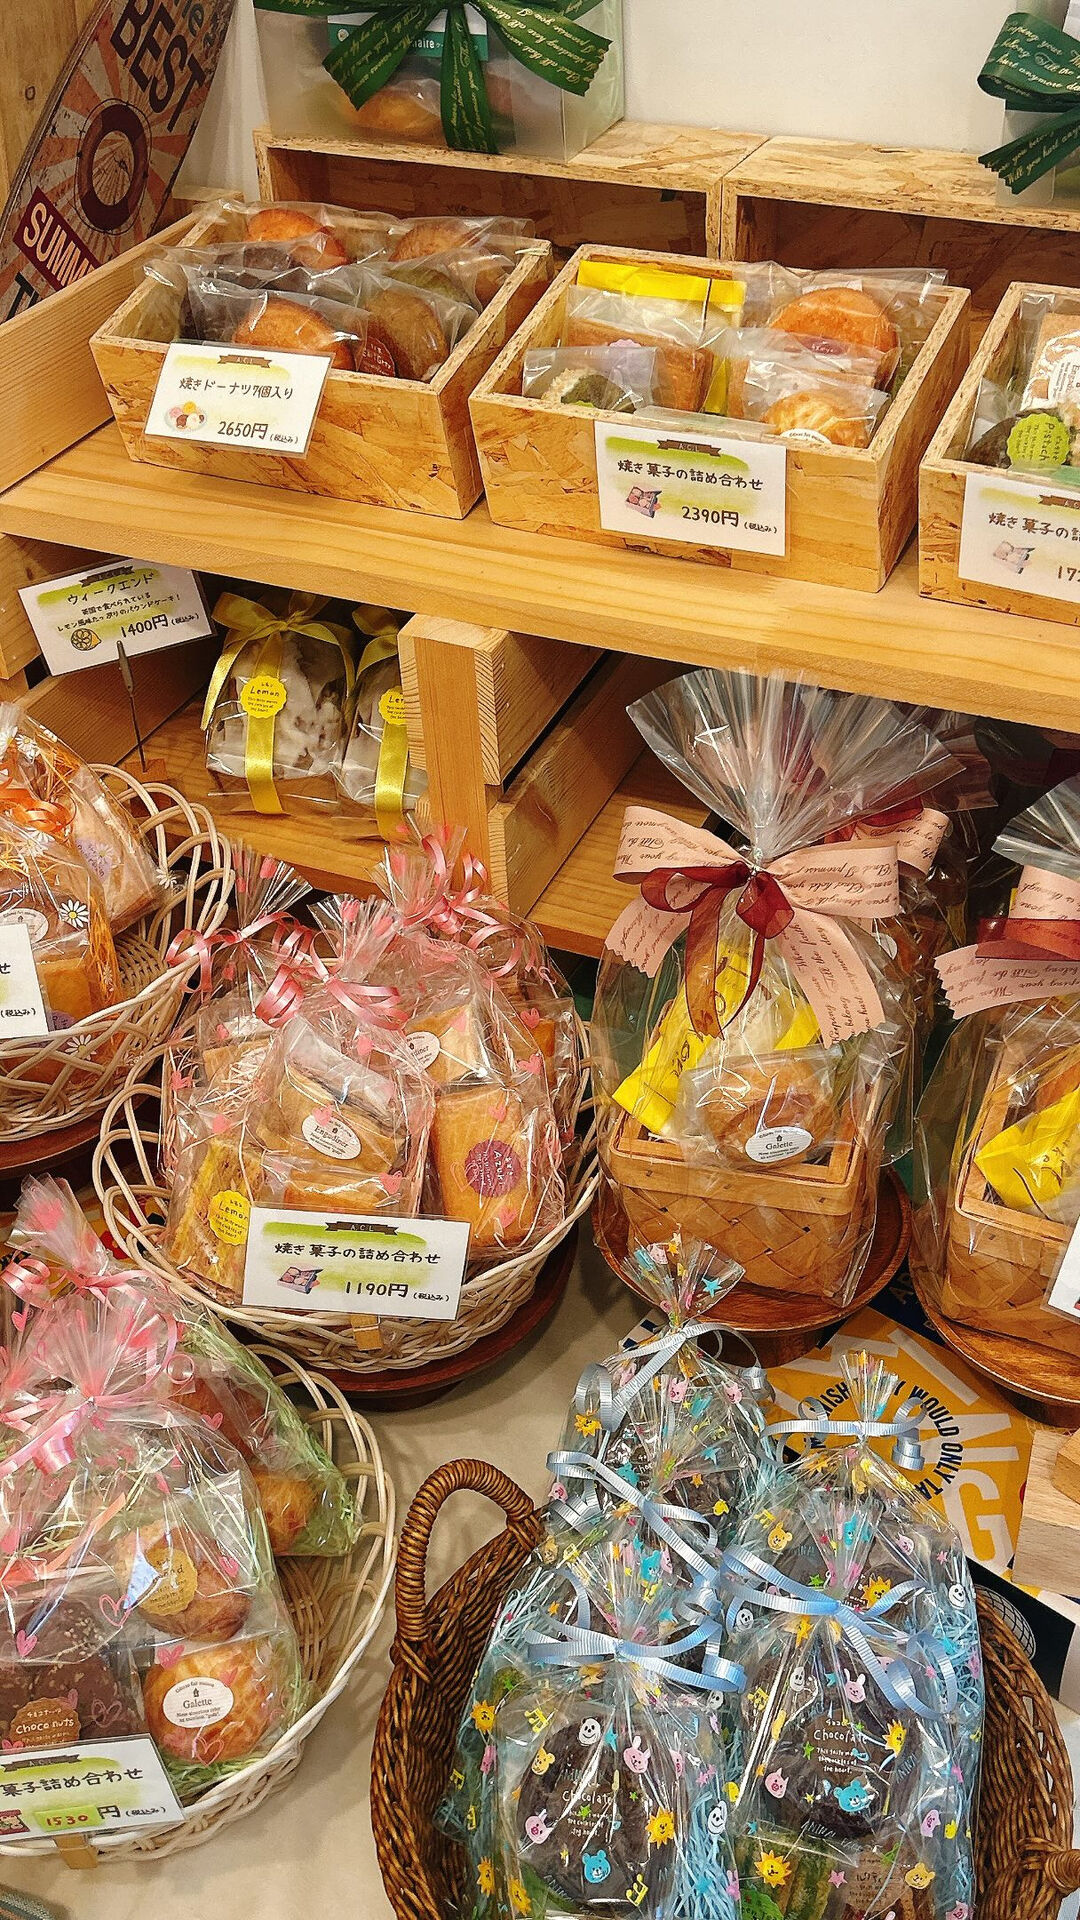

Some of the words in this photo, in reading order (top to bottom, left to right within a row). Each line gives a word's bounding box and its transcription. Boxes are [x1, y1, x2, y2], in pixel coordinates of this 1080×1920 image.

[179, 376, 294, 400] 焼きドーナツ7個入り
[217, 420, 269, 441] 2650円
[617, 459, 764, 491] 焼き菓子の詰め合わせ
[682, 505, 739, 528] 2390円
[121, 613, 169, 638] 1400円
[274, 1242, 441, 1265] 焼き菓子の詰め合わせ
[345, 1281, 409, 1298] 1190円
[932, 1442, 964, 1484] ONLY
[182, 1698, 213, 1710] Galette
[1, 1768, 144, 1797] 菓子詰め合わせ
